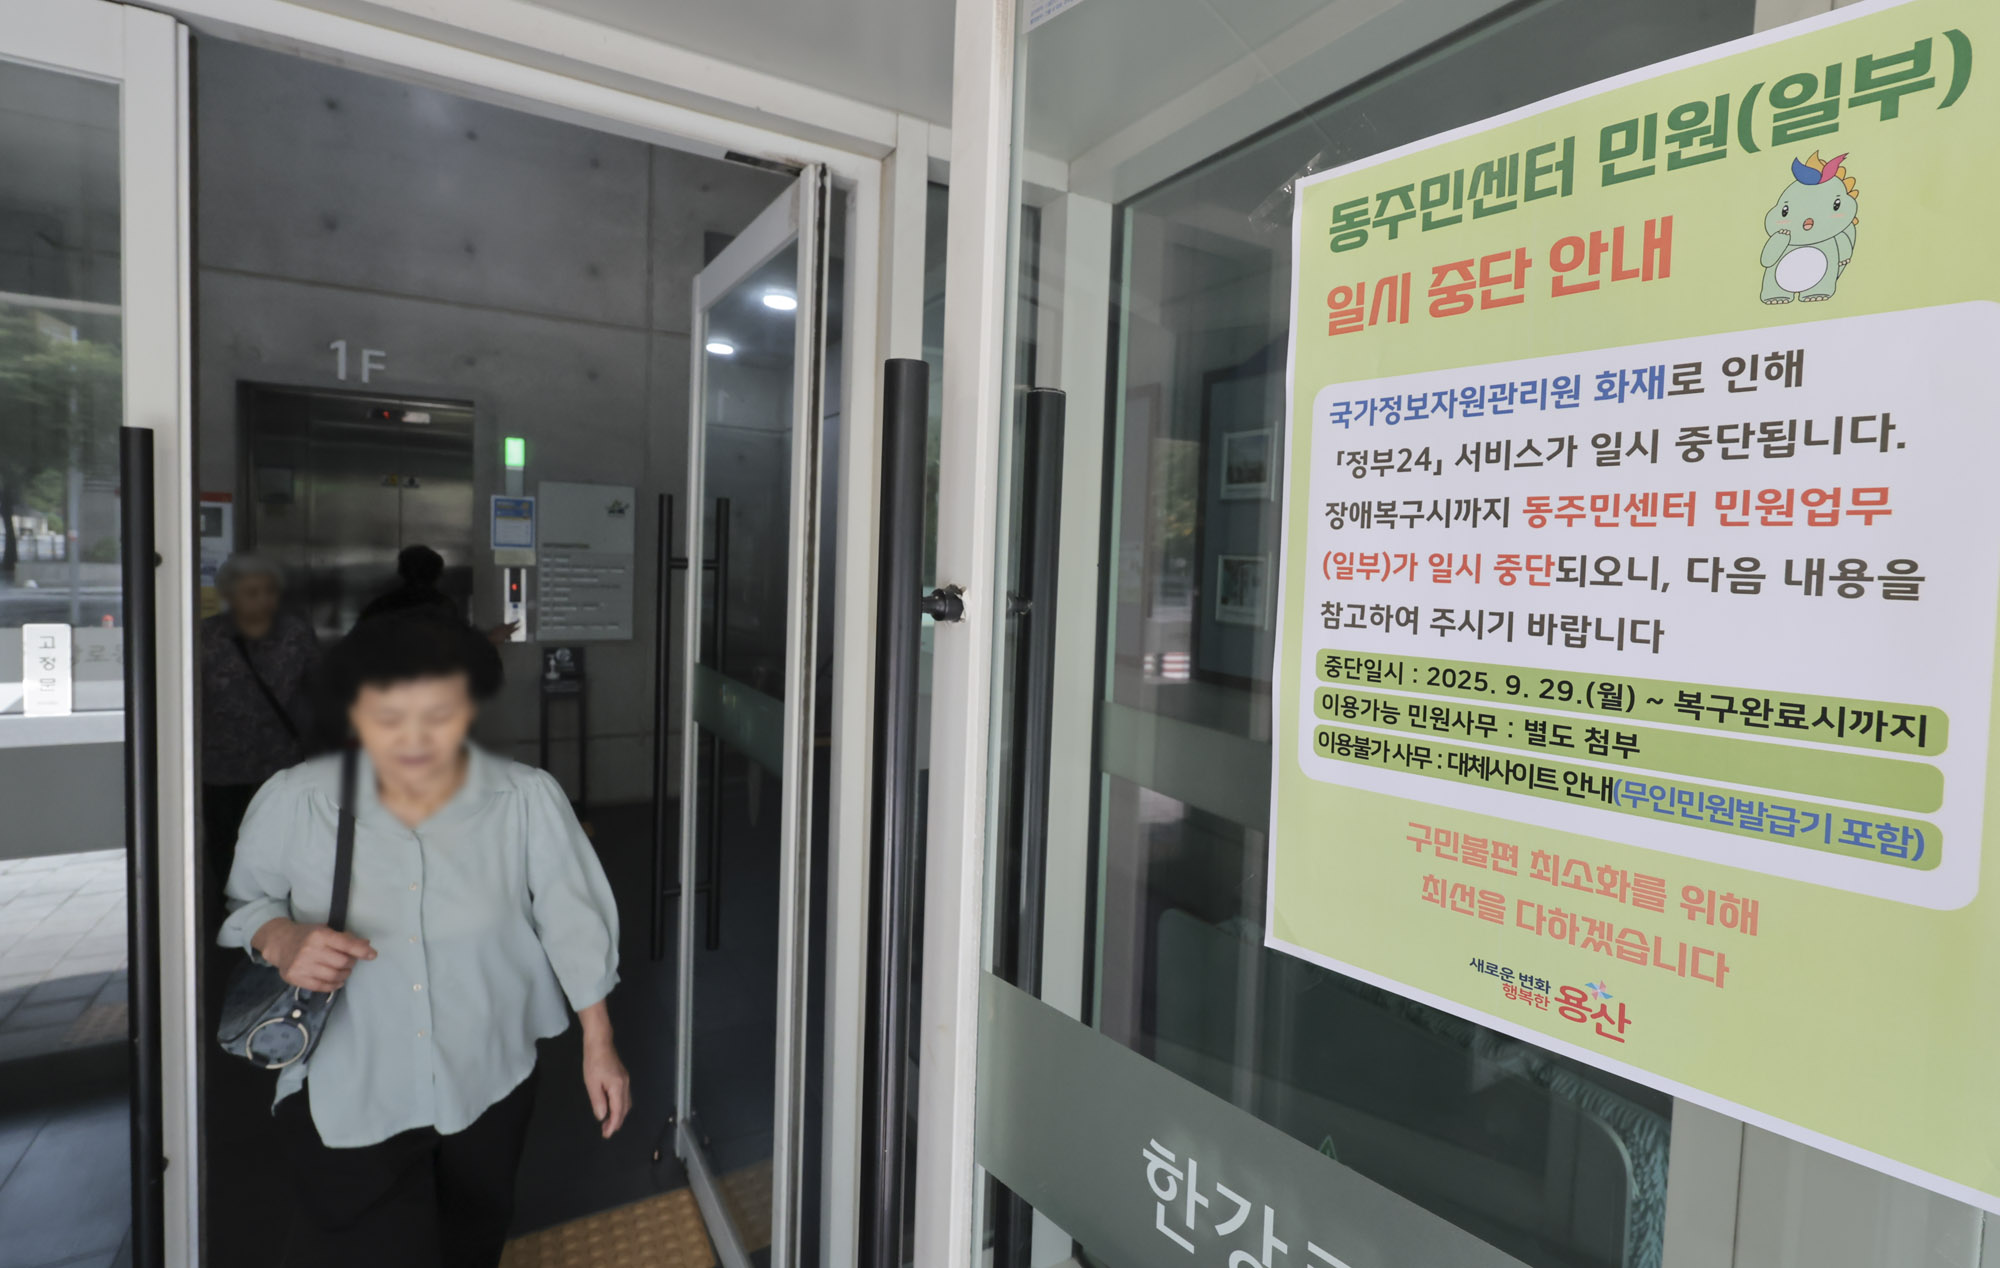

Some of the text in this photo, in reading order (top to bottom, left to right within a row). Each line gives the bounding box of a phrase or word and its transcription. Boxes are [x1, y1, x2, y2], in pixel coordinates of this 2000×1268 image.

[1329, 29, 1972, 253] 동주민센터 민원(일부)
[1327, 216, 1673, 336] 일시 중단 안내
[329, 339, 386, 383] 1F
[1330, 349, 1804, 429] 국가정보자원관리원 화재로 인해
[1455, 435, 1578, 472] 서비스가
[1591, 429, 1659, 467] 일시
[1675, 413, 1905, 463] 중단됩니다.
[1325, 487, 1892, 530] 장애복구시까지 동주민센터 민원업무
[1323, 551, 1925, 601] (일부)가 일시 중단되오니, 다음 내용을
[1321, 601, 1665, 654] 참고하여 주시기 바랍니다
[1321, 693, 1400, 725] 이용가능
[1408, 704, 1498, 738] 민원사무
[1524, 718, 1575, 749] 별도
[1584, 726, 1641, 760] 첨부
[1324, 655, 1403, 685] 중단일시
[1426, 666, 1496, 694] 2025.
[1505, 674, 1529, 698] 9.
[1674, 690, 1927, 748] 복구완료시까지
[1447, 751, 1559, 791] 대체사이트
[1838, 817, 1925, 862] 포함)
[1407, 823, 1758, 936] 구민불편 최소화를 위해
[1422, 875, 1729, 988] 최선을 다하겠습니다
[1469, 957, 1551, 995] 새로운 변화
[1502, 983, 1551, 1011] 행복한
[1554, 985, 1632, 1043] 용산
[1142, 1138, 1353, 1268] 한강
